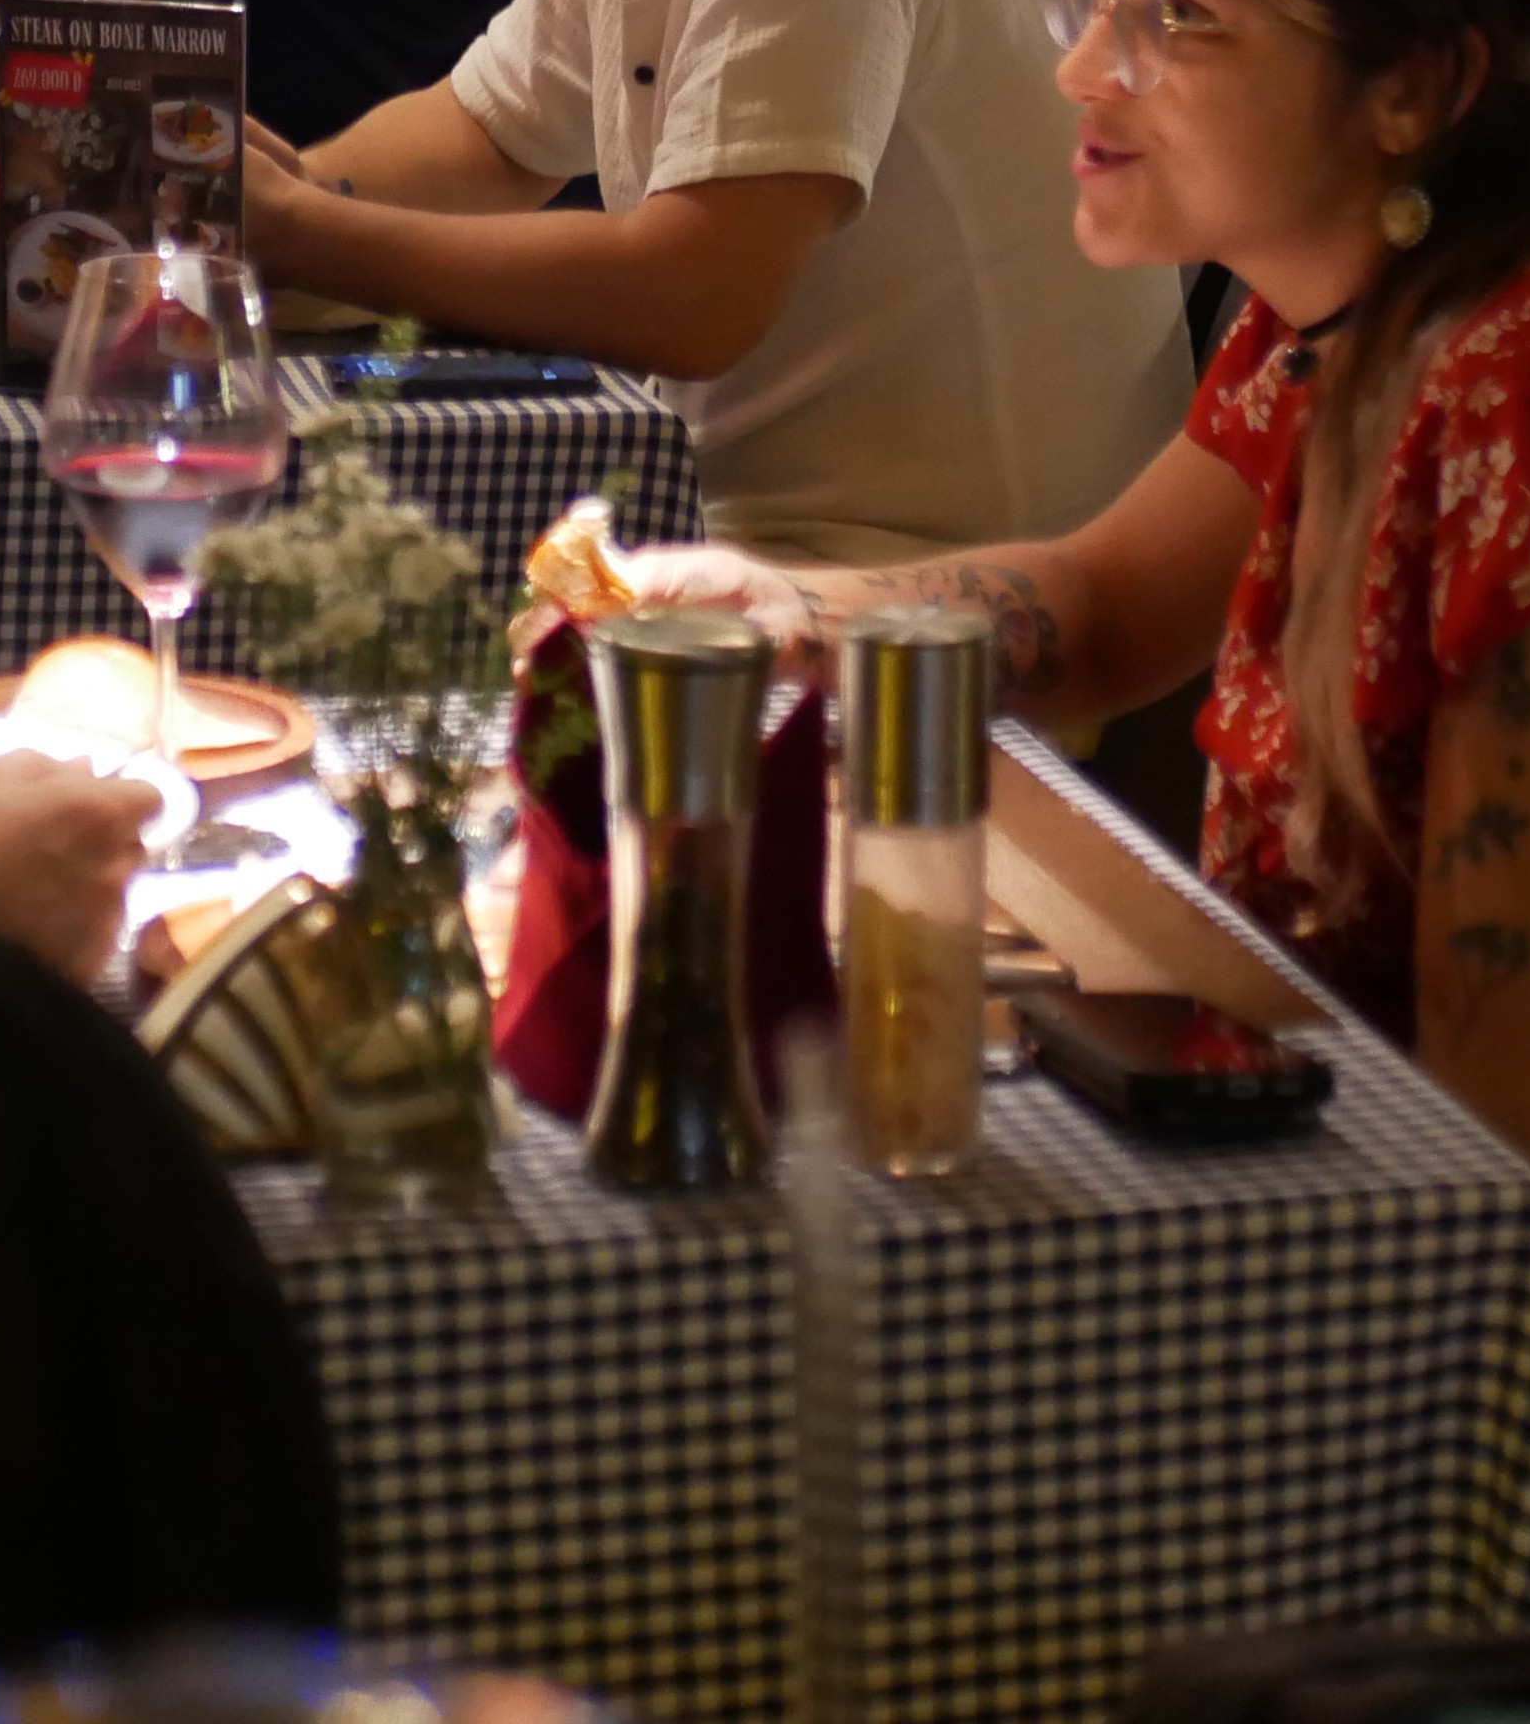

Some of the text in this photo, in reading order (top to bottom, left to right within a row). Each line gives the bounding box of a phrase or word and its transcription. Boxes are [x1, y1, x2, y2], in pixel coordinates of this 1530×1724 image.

[10, 16, 227, 56] STEAK ON BONE MARROW
